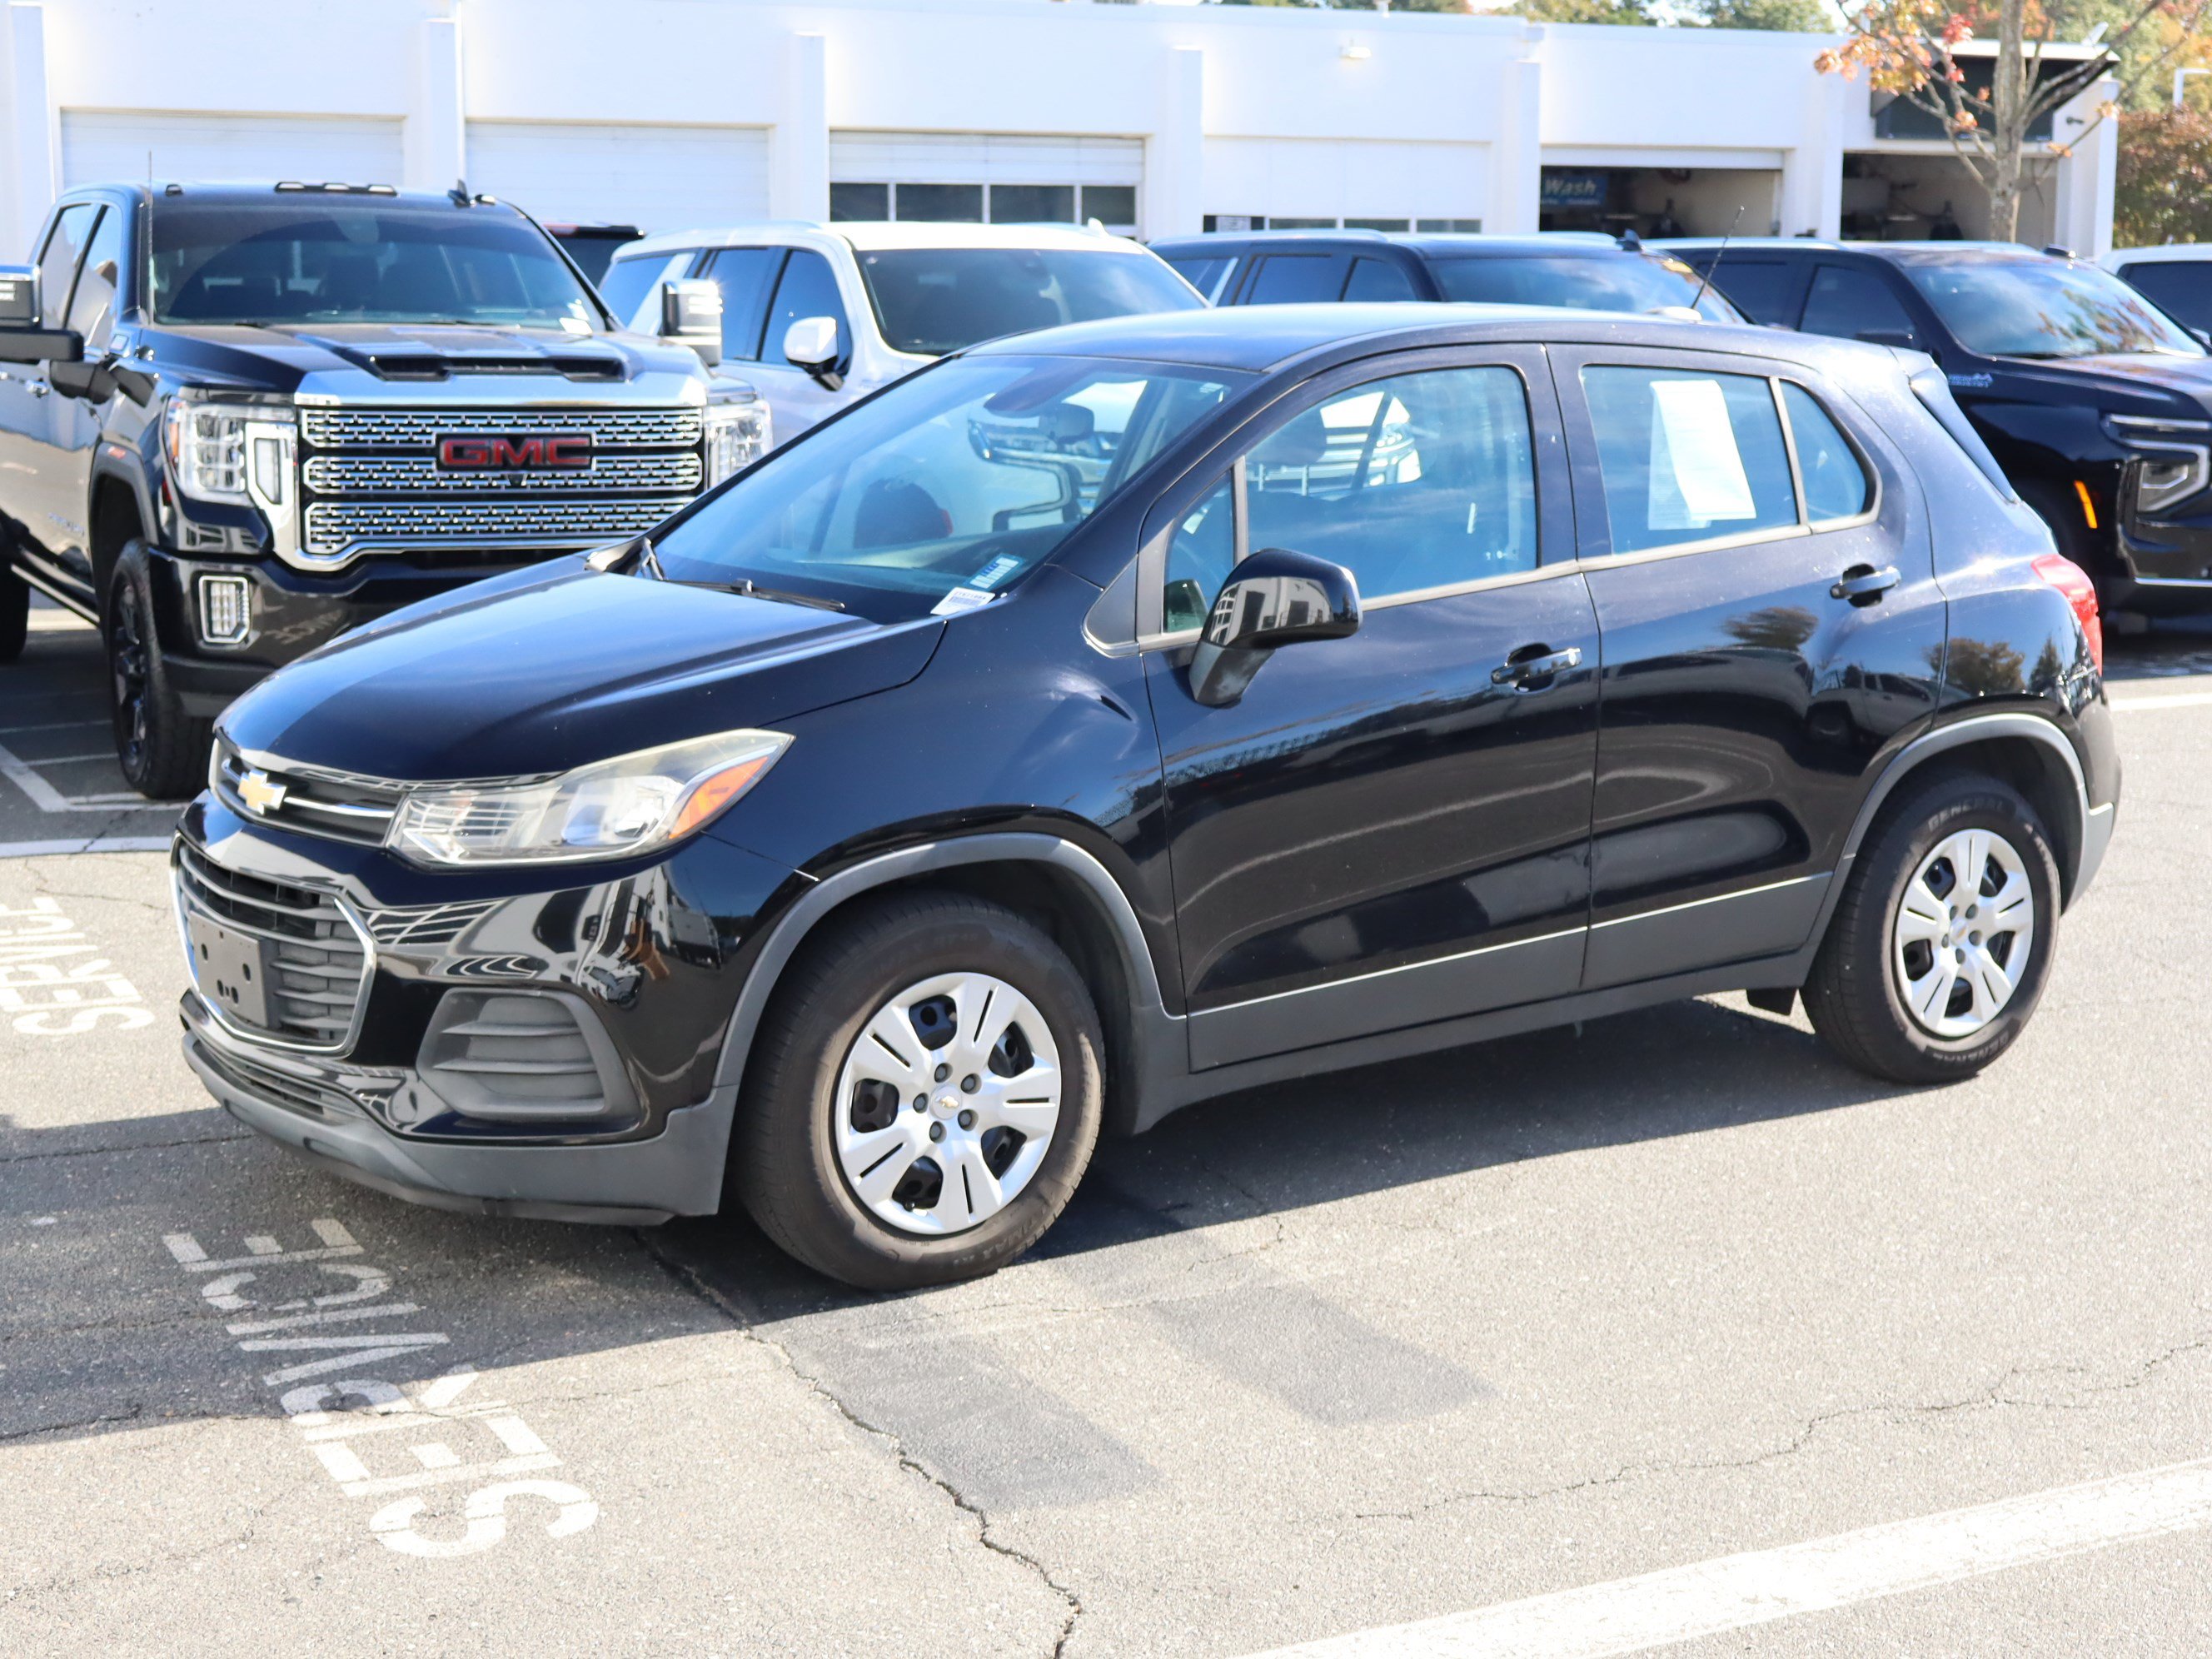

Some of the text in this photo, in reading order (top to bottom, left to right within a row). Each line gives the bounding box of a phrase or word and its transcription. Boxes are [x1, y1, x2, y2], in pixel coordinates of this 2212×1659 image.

[1545, 177, 1597, 196] Wash
[440, 438, 590, 466] GMC
[162, 1218, 598, 1558] SERVICE
